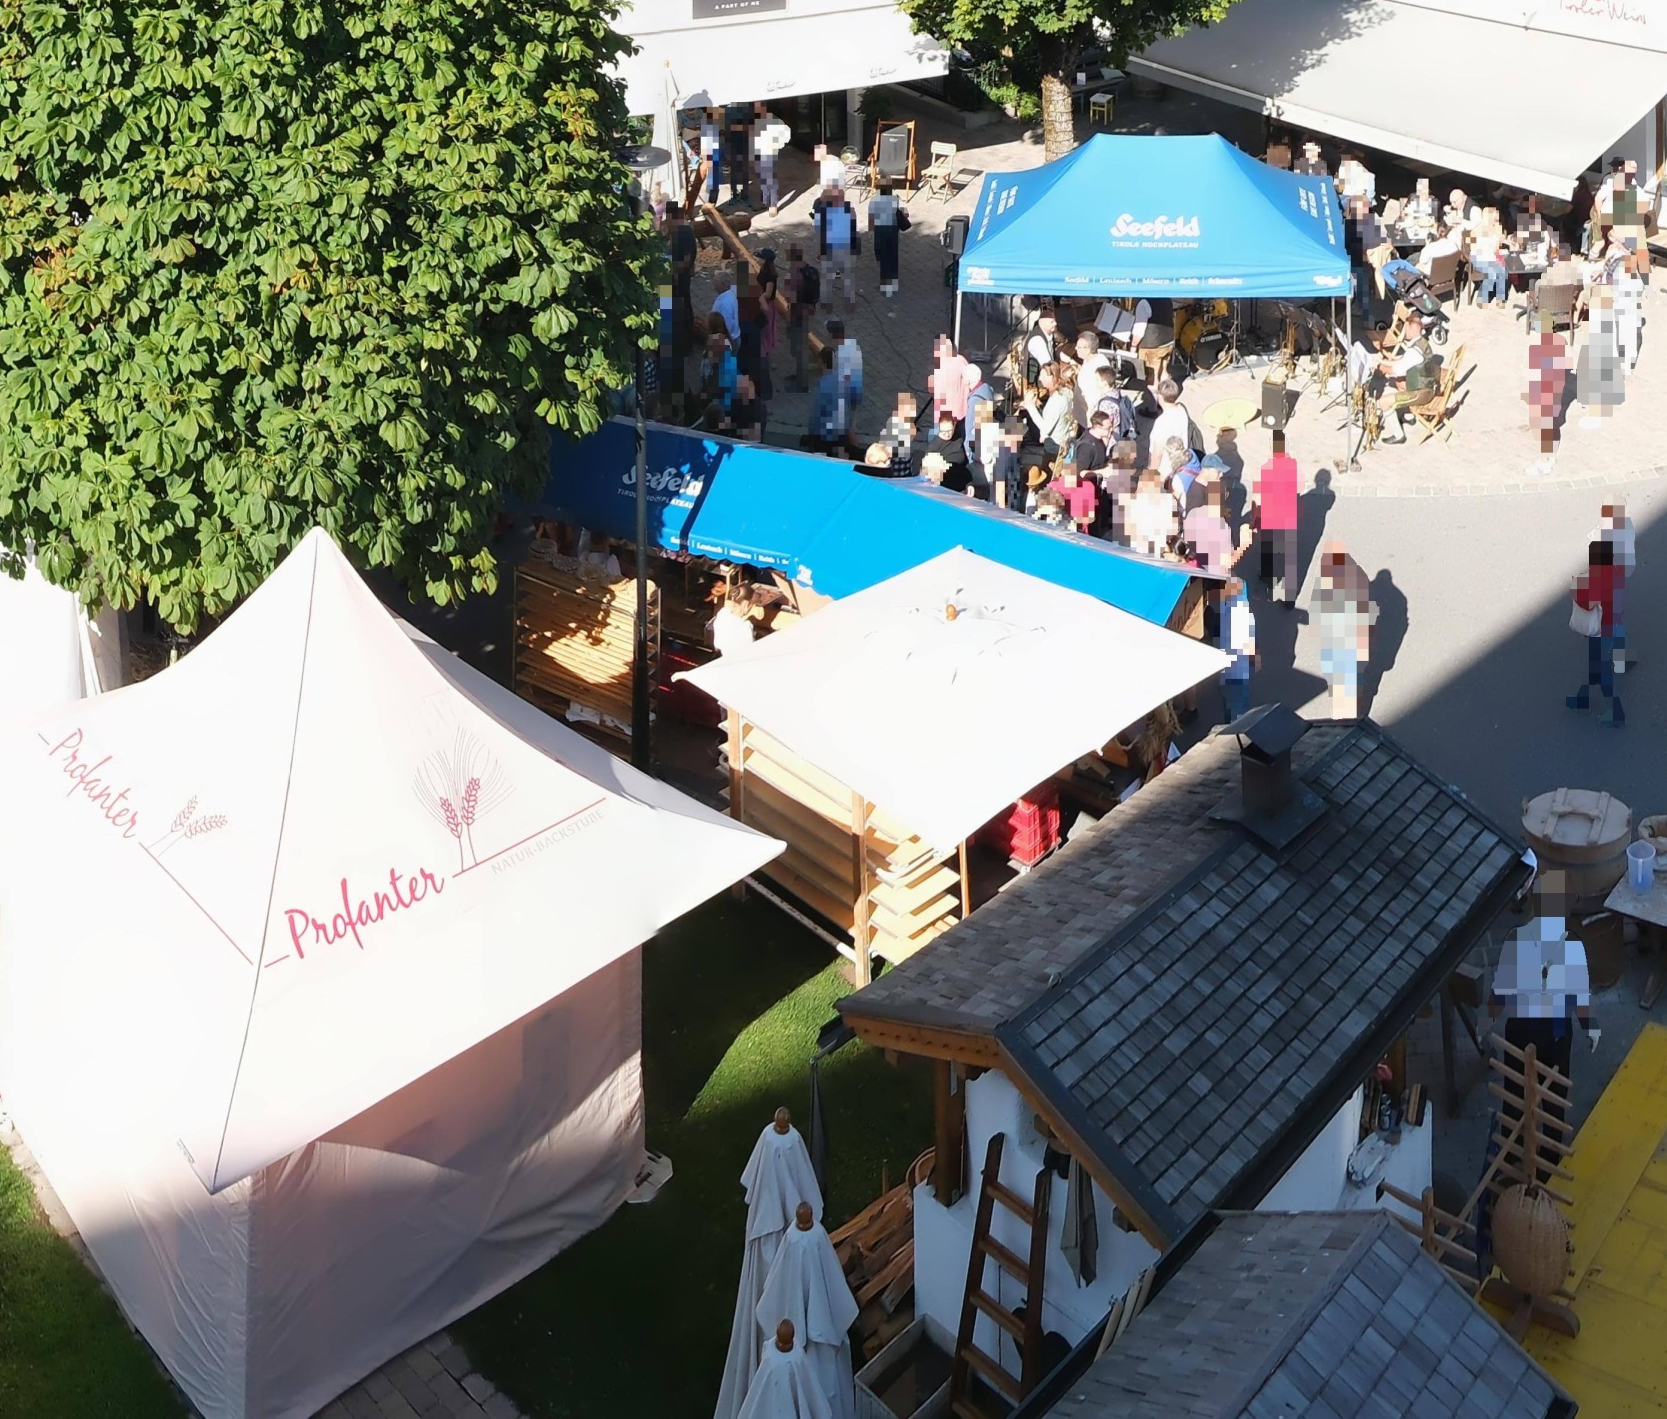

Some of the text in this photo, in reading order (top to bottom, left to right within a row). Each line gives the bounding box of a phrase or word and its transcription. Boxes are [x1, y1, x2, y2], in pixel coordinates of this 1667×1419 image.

[1109, 212, 1201, 239] Seefeld
[617, 488, 638, 498] TIROL
[48, 727, 137, 839] Profanter
[285, 867, 444, 960] Profanter
